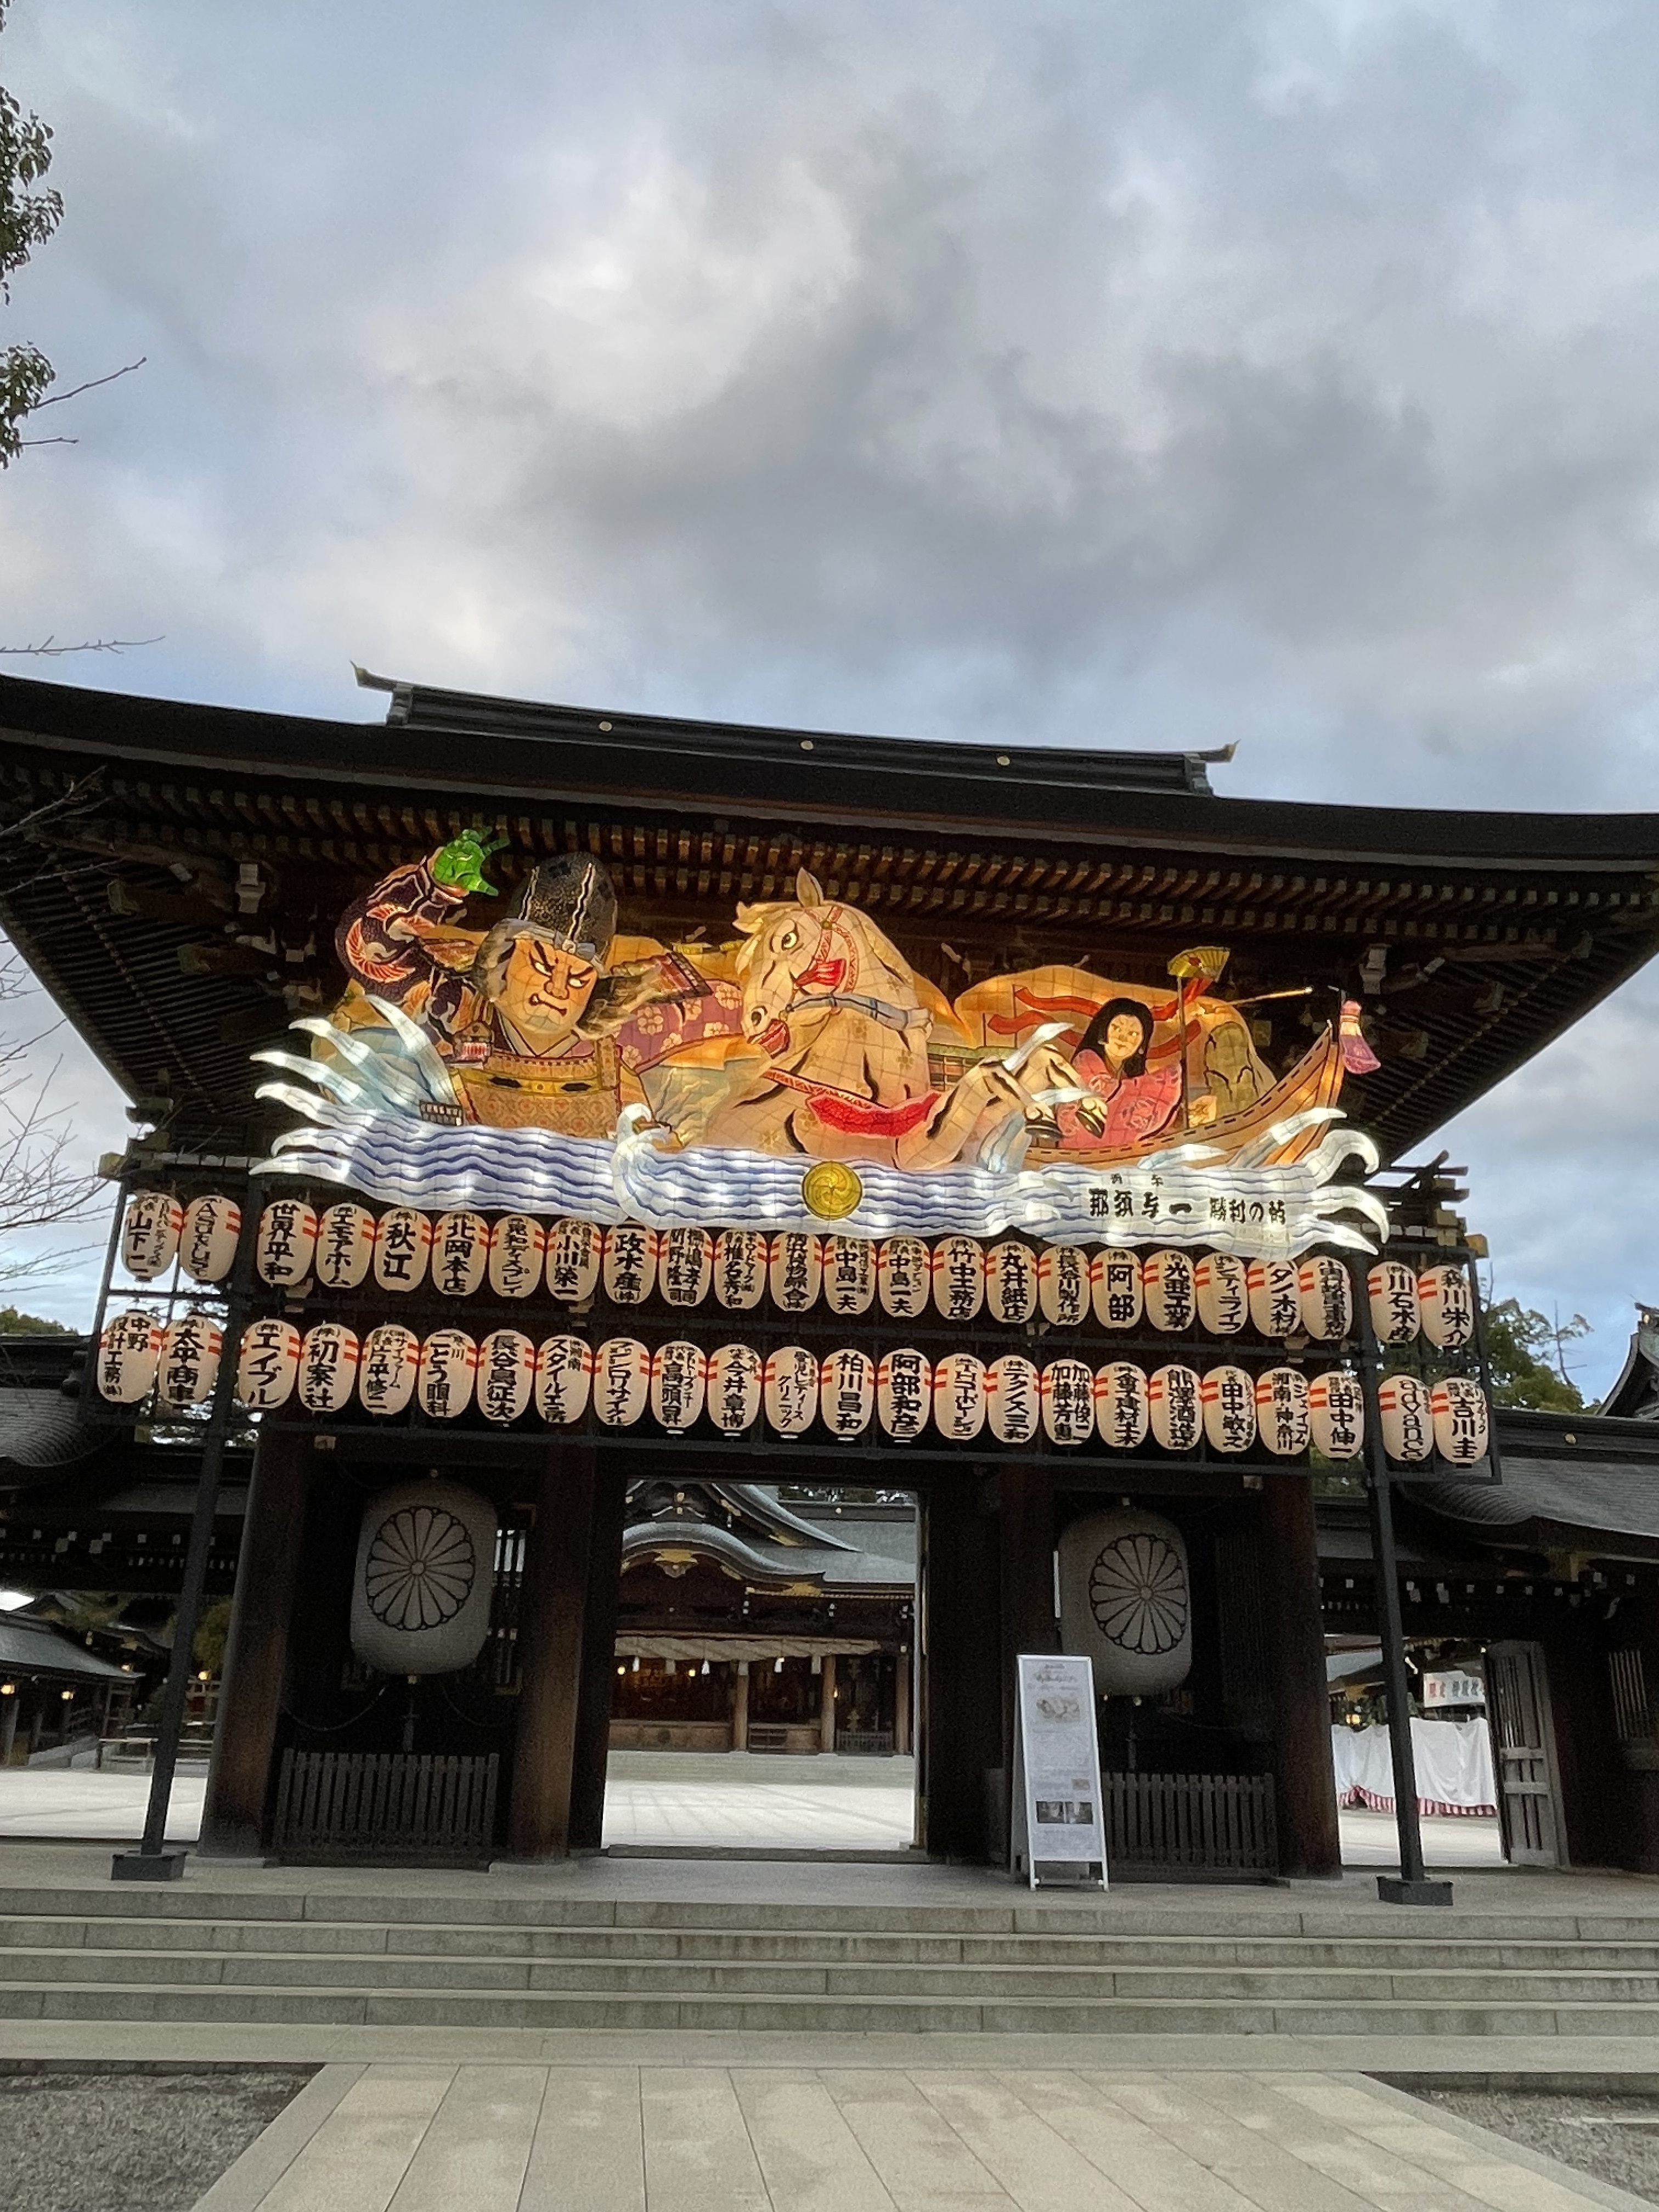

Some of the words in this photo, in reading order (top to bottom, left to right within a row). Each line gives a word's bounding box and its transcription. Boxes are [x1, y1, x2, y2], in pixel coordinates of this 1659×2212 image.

[264, 1203, 300, 1280] 世界平和
[127, 1317, 151, 1352] 中野
[1328, 1393, 1356, 1453] 田中伸一
